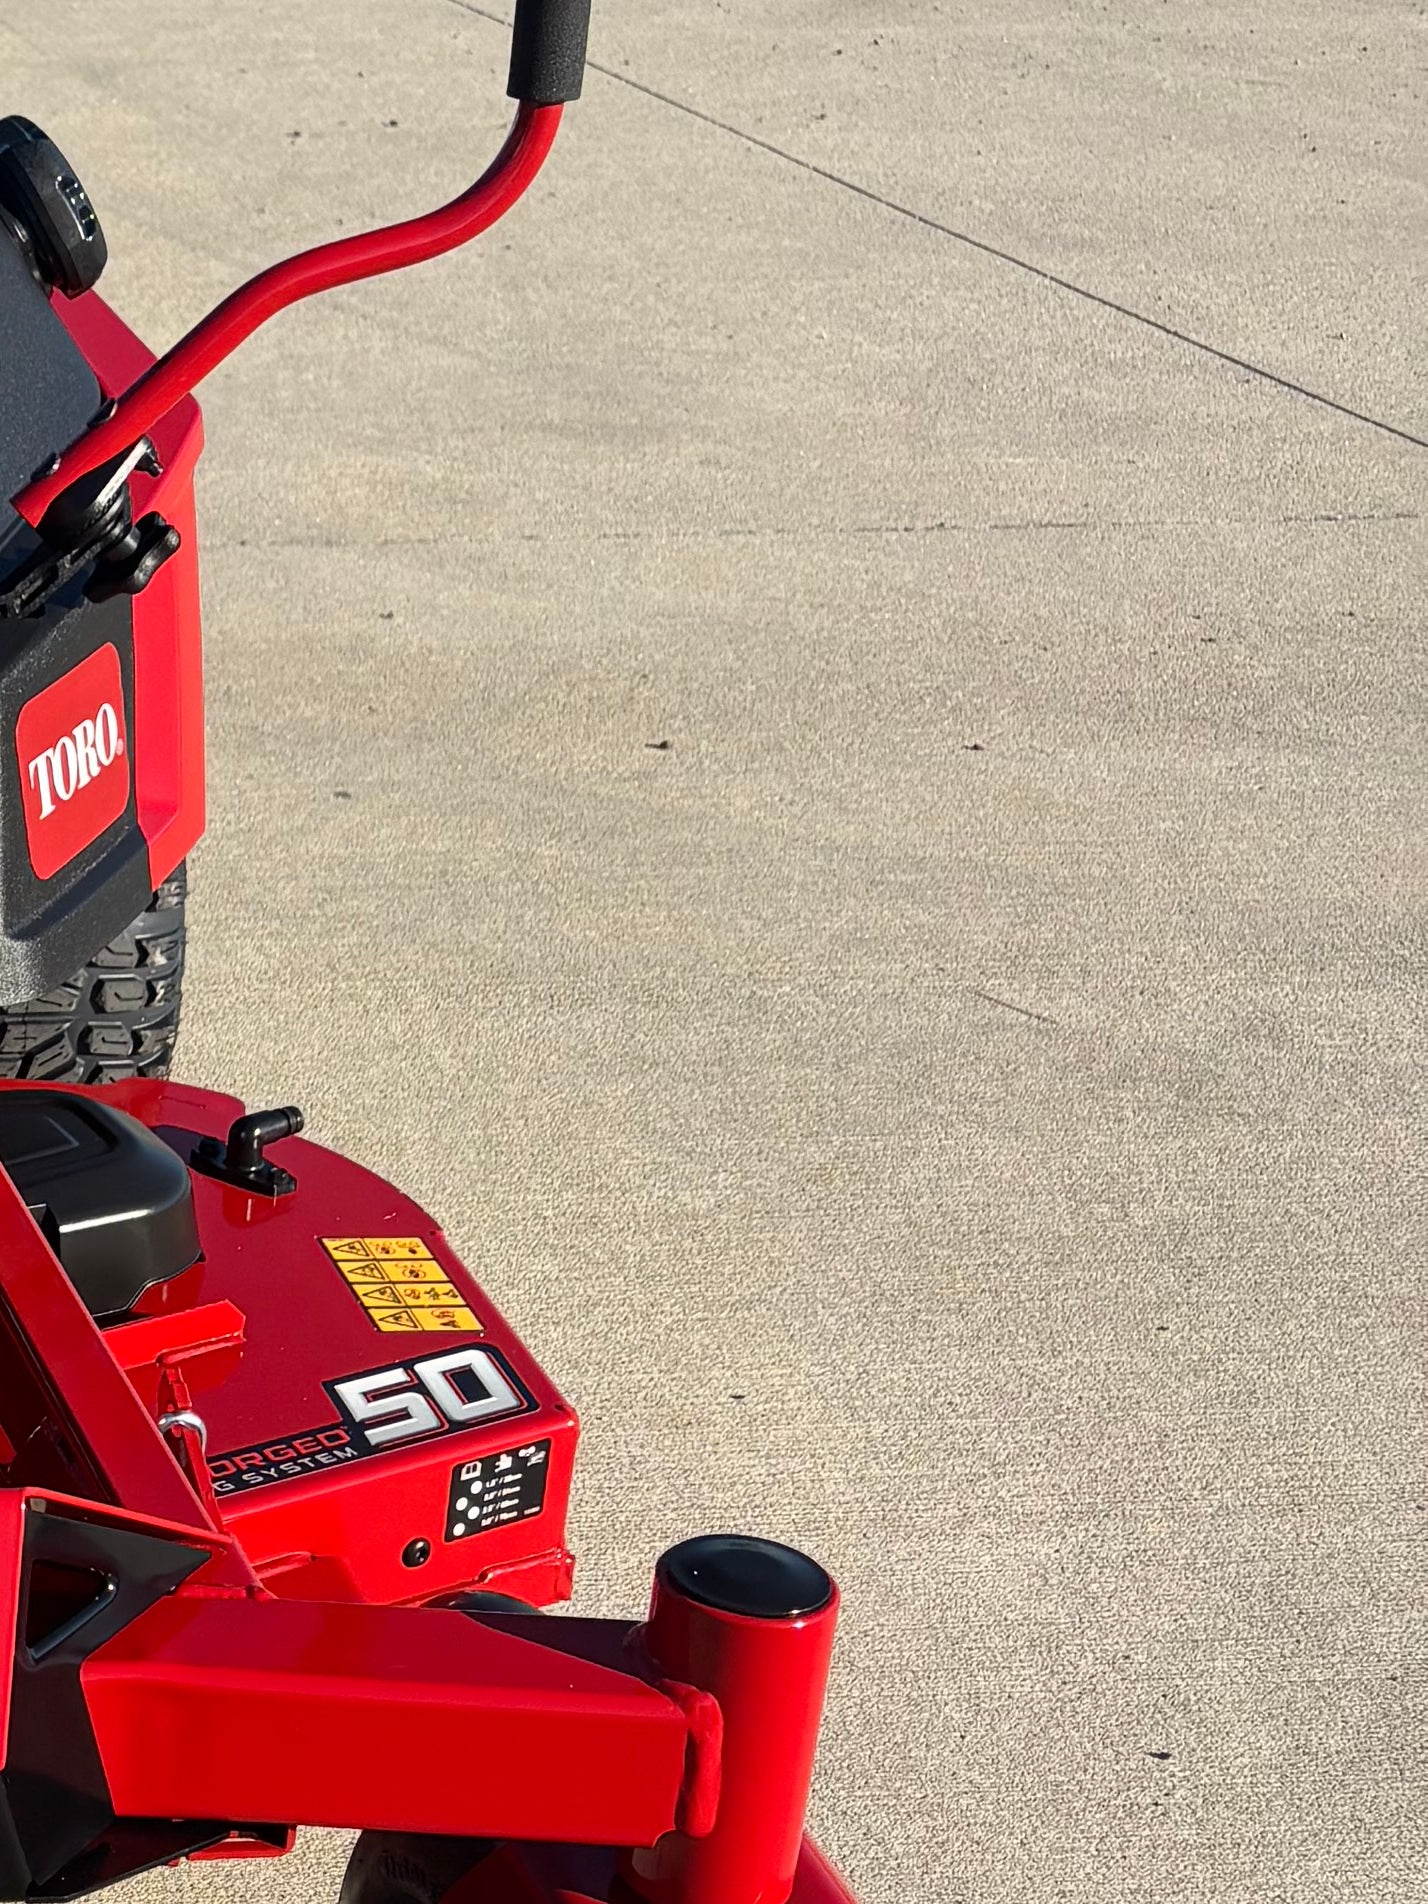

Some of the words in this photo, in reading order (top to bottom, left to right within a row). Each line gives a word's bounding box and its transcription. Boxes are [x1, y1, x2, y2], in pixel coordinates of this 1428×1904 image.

[334, 1349, 522, 1447] 50
[208, 1426, 352, 1479] ORGED
[242, 1446, 358, 1484] SYSTEM
